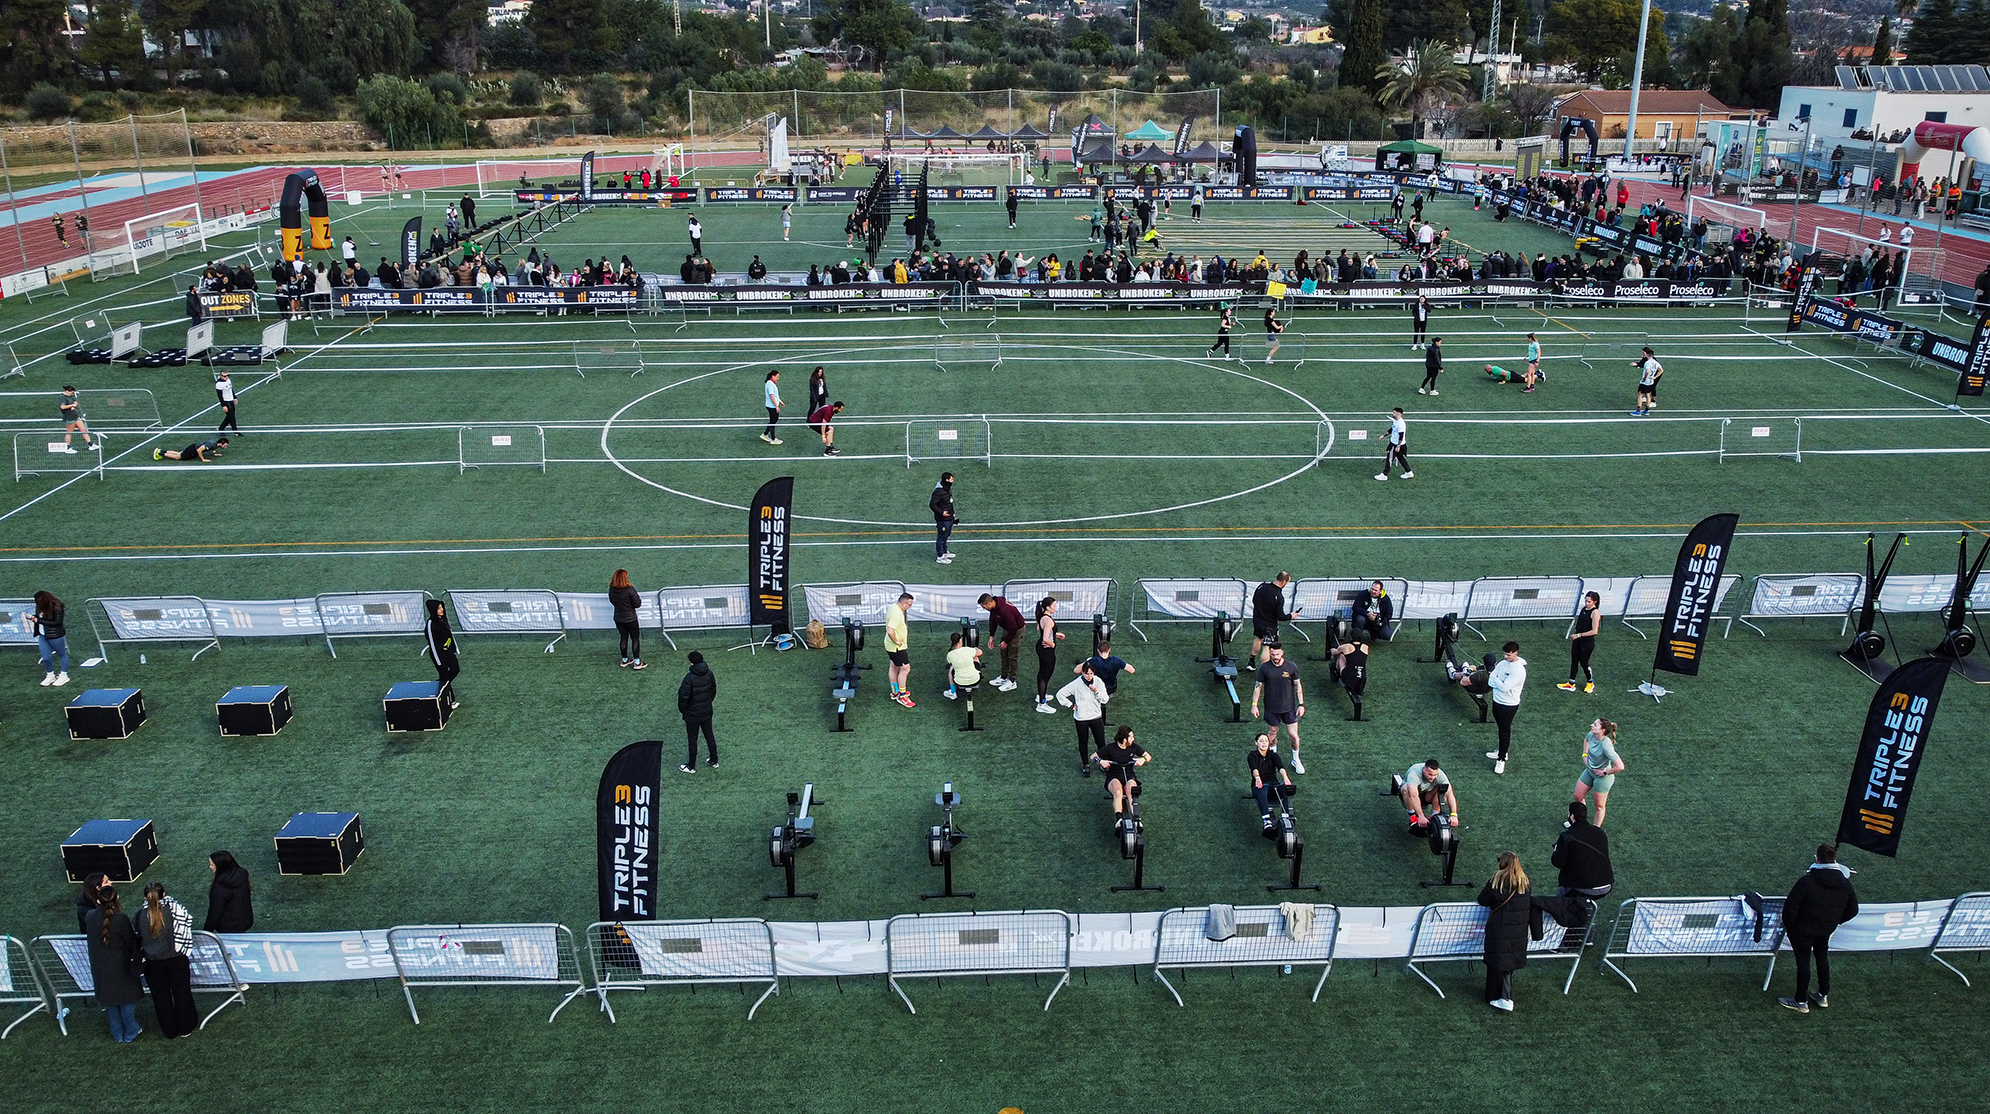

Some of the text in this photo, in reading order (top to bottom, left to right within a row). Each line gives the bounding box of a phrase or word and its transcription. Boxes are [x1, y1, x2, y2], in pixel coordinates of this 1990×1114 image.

[133, 238, 153, 250] UIJOTE
[200, 294, 250, 306] OUT ZONES
[1813, 311, 1846, 327] FITNESS
[1817, 305, 1848, 320] TRIPLE3
[1858, 326, 1892, 340] FITNESS
[1932, 342, 1969, 365] UNBROK
[760, 506, 772, 588] TRIPLE3
[772, 506, 786, 591] FITNESS
[1673, 543, 1707, 634] TRIPLE3
[1686, 544, 1722, 638] FITNESS
[1864, 692, 1910, 800] TRIPLE3
[1882, 695, 1928, 809] FITNESS
[614, 784, 631, 912] TRIPLE3
[633, 784, 650, 916] FITNESS
